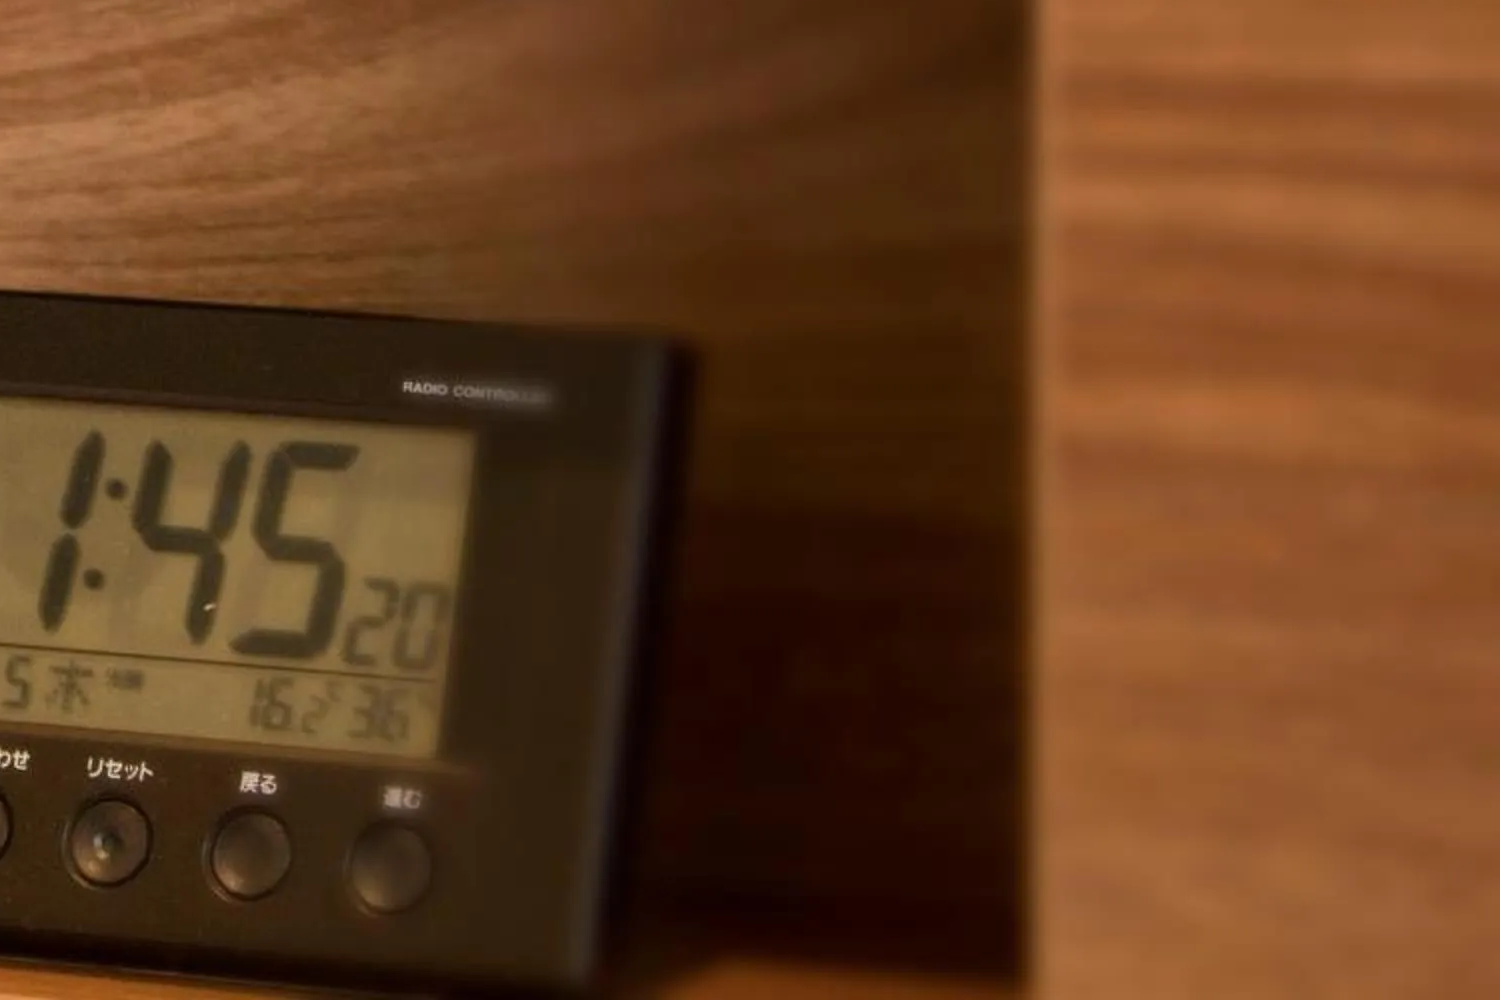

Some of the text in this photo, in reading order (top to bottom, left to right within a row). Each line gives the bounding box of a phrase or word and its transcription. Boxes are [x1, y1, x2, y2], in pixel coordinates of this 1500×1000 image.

[402, 380, 449, 396] RADIO
[37, 430, 451, 669] 1:45 20
[87, 757, 154, 782] リセット
[239, 771, 278, 795] 戻る
